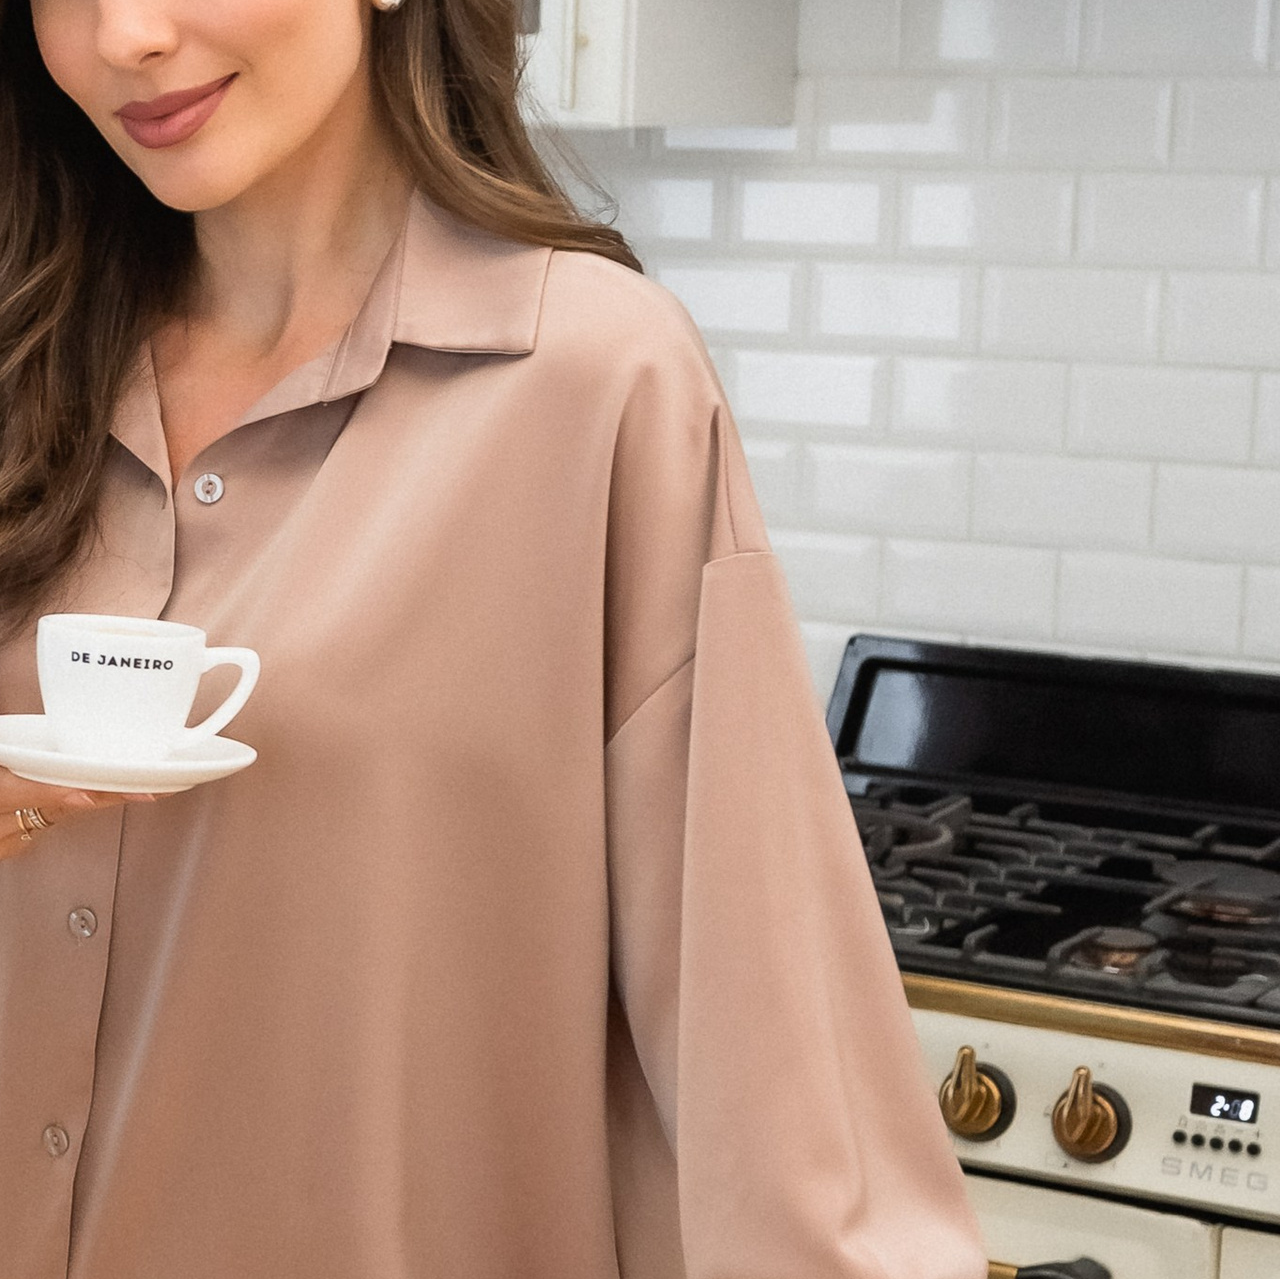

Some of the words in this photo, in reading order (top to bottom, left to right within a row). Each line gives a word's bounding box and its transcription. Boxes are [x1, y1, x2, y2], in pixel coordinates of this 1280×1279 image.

[71, 651, 91, 664] DE
[97, 654, 174, 671] JANEIRO
[1161, 1157, 1268, 1191] SMEG
